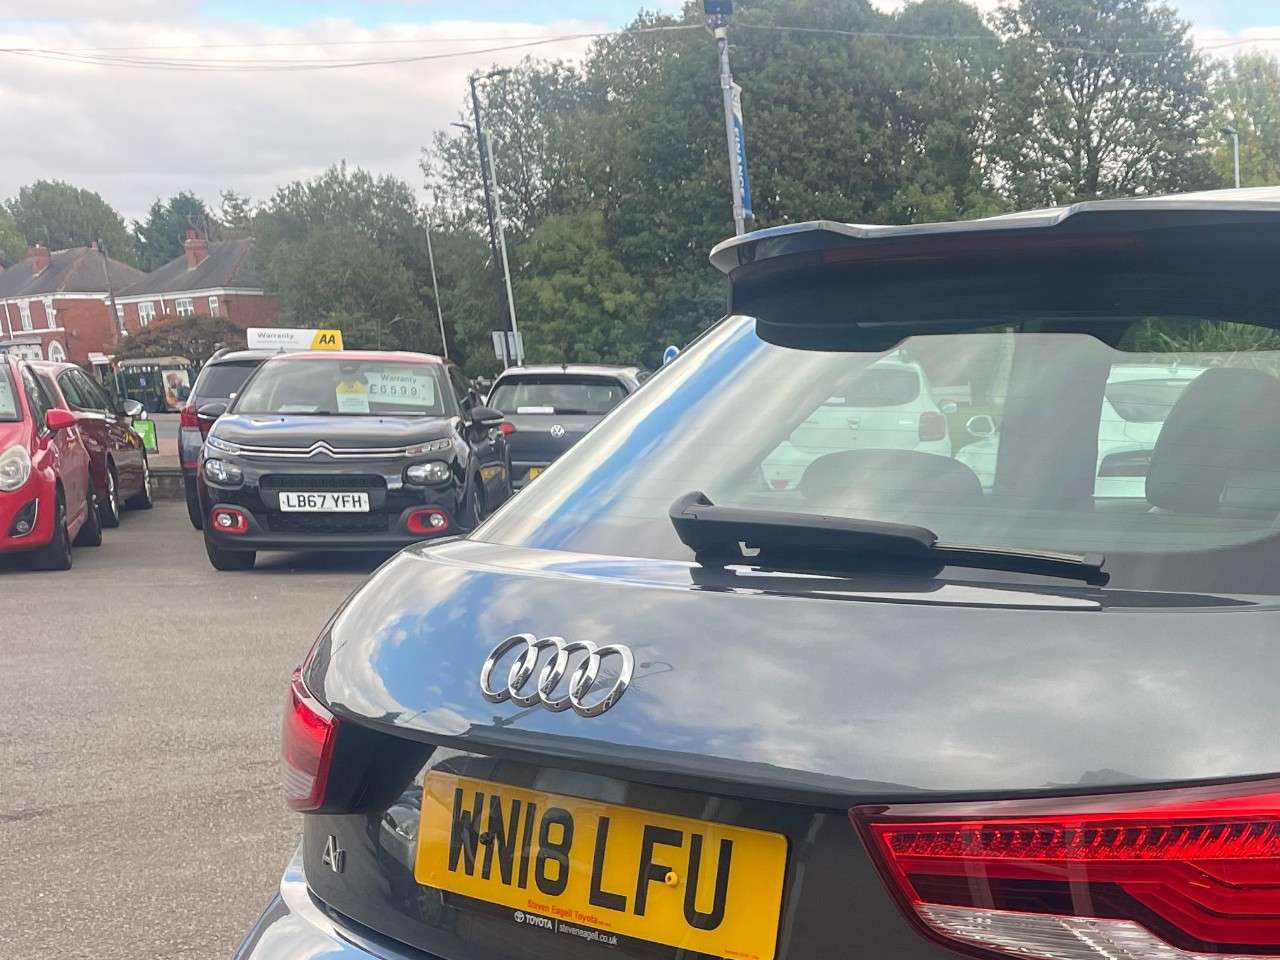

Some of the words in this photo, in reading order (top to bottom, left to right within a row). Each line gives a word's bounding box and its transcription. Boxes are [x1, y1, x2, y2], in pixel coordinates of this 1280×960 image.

[257, 332, 294, 340] Warranty
[319, 334, 336, 345] AA
[382, 374, 417, 384] Warranty
[286, 494, 326, 508] LB67
[332, 494, 362, 508] YFH
[448, 788, 574, 896] WN18
[588, 816, 733, 931] LFU
[527, 899, 550, 912] Steven
[574, 910, 598, 924] Toyota
[525, 914, 553, 930] TOYOTA
